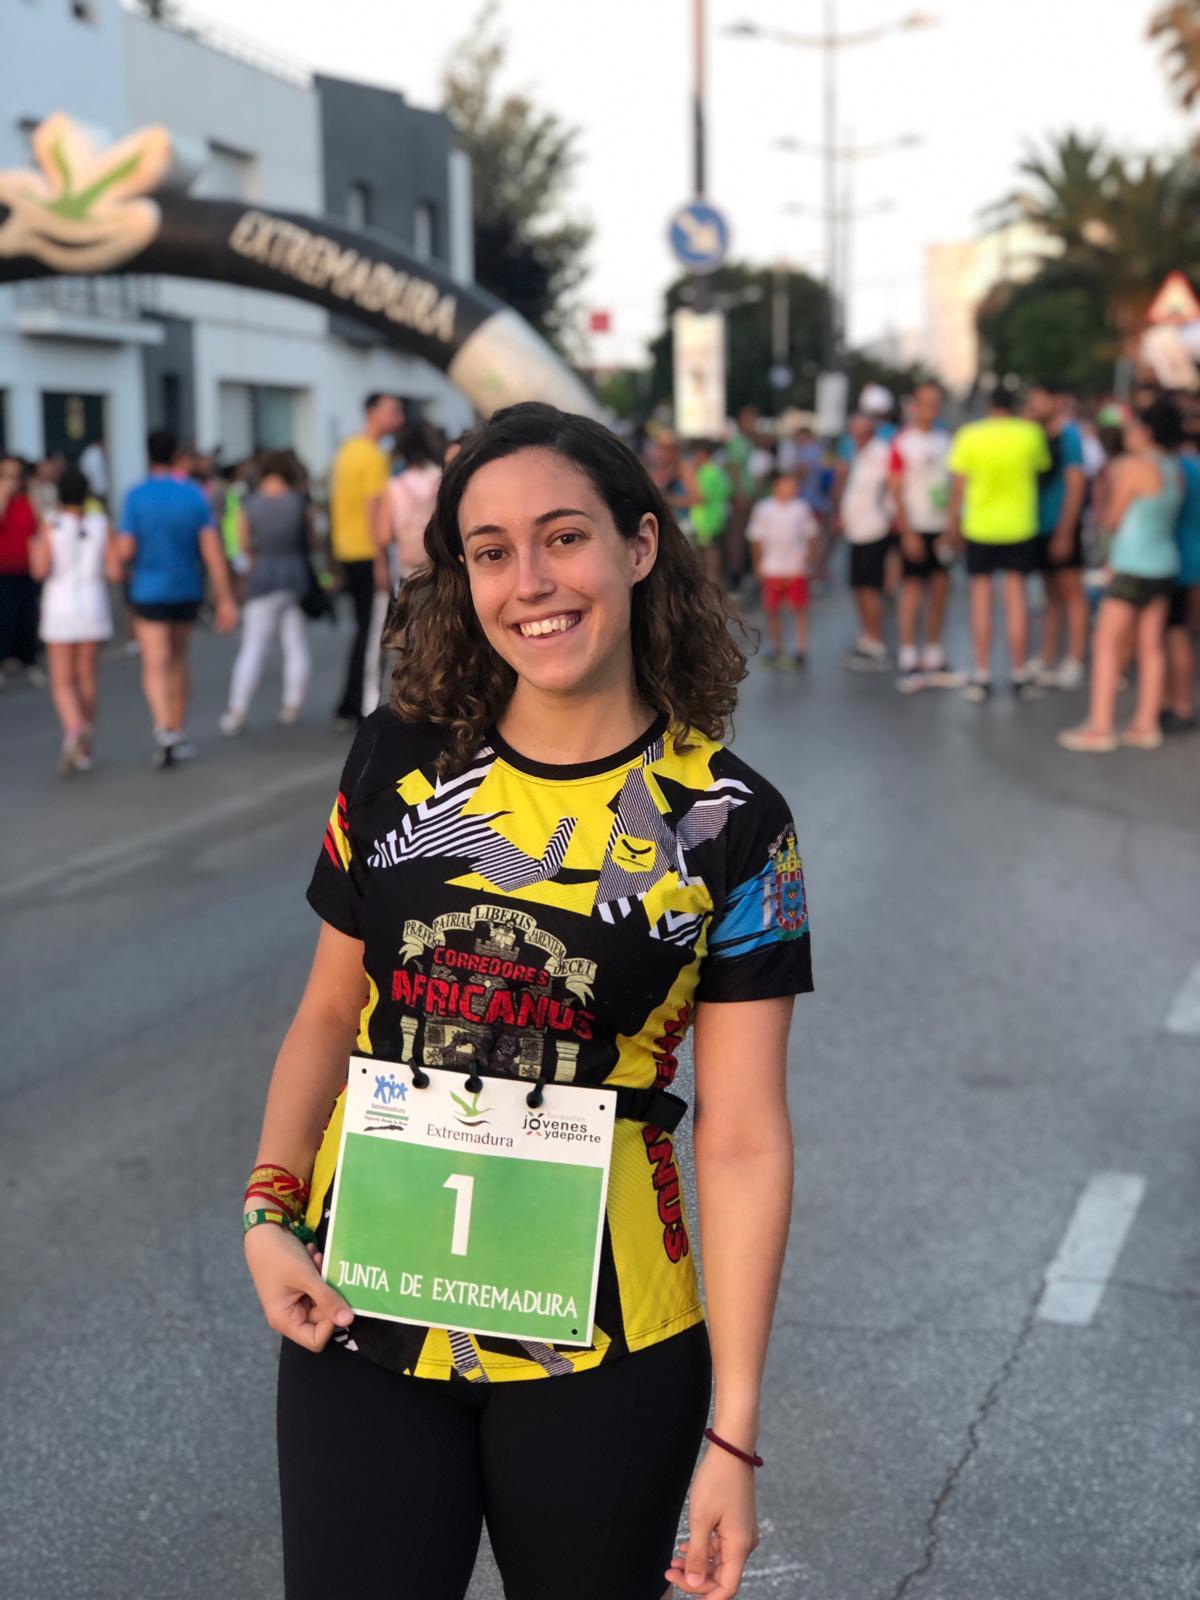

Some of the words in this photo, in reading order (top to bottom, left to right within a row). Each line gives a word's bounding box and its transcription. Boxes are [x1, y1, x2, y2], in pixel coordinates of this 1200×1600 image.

[229, 211, 457, 342] EXTREMADURA
[433, 946, 549, 986] CORREDORES
[475, 907, 532, 930] LIBERIS
[554, 960, 593, 977] DECET
[391, 969, 595, 1040] AFRICANUS
[426, 1123, 513, 1147] Extremadura
[442, 1173, 475, 1256] 1
[337, 1260, 390, 1292] JUNTA
[400, 1272, 424, 1297] DE
[432, 1278, 578, 1318] EXTREMADURA
